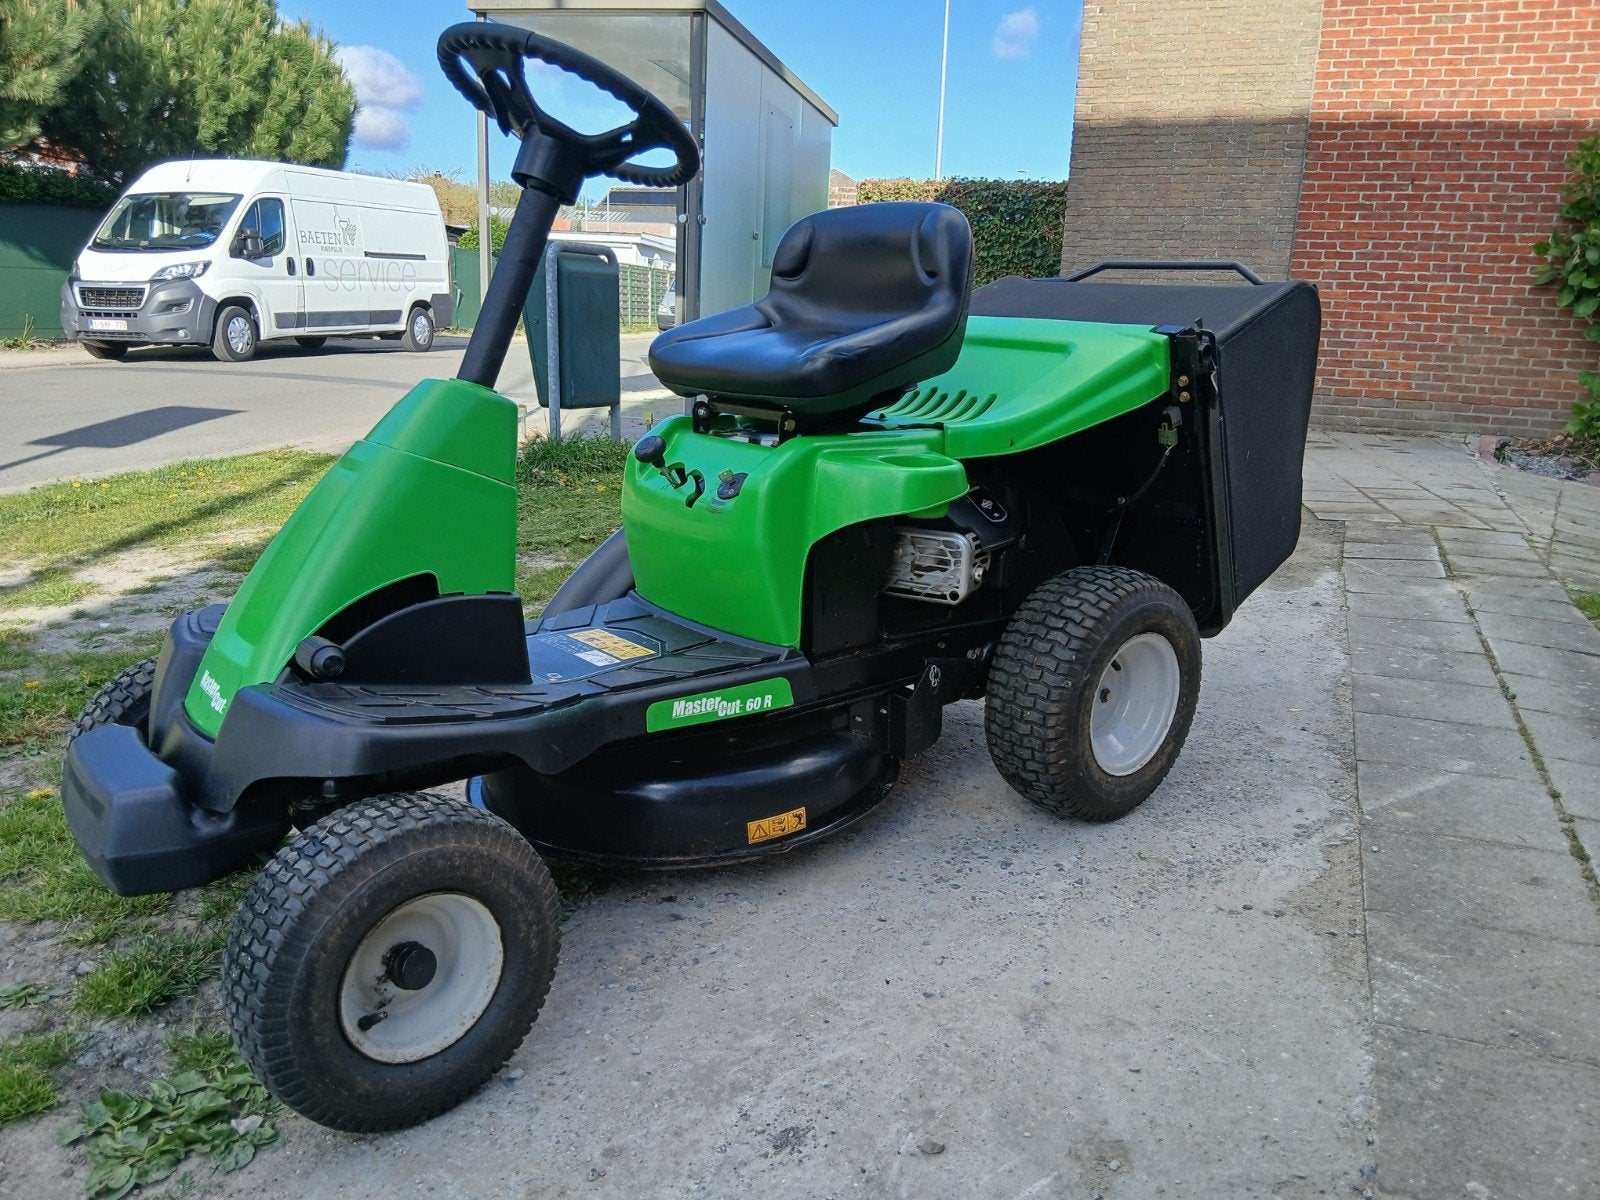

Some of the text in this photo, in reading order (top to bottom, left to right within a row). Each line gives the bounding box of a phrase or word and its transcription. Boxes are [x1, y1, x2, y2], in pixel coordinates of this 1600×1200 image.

[300, 230, 342, 245] BAETEN
[323, 258, 416, 292] service
[745, 696, 762, 712] 60
[763, 694, 773, 709] R
